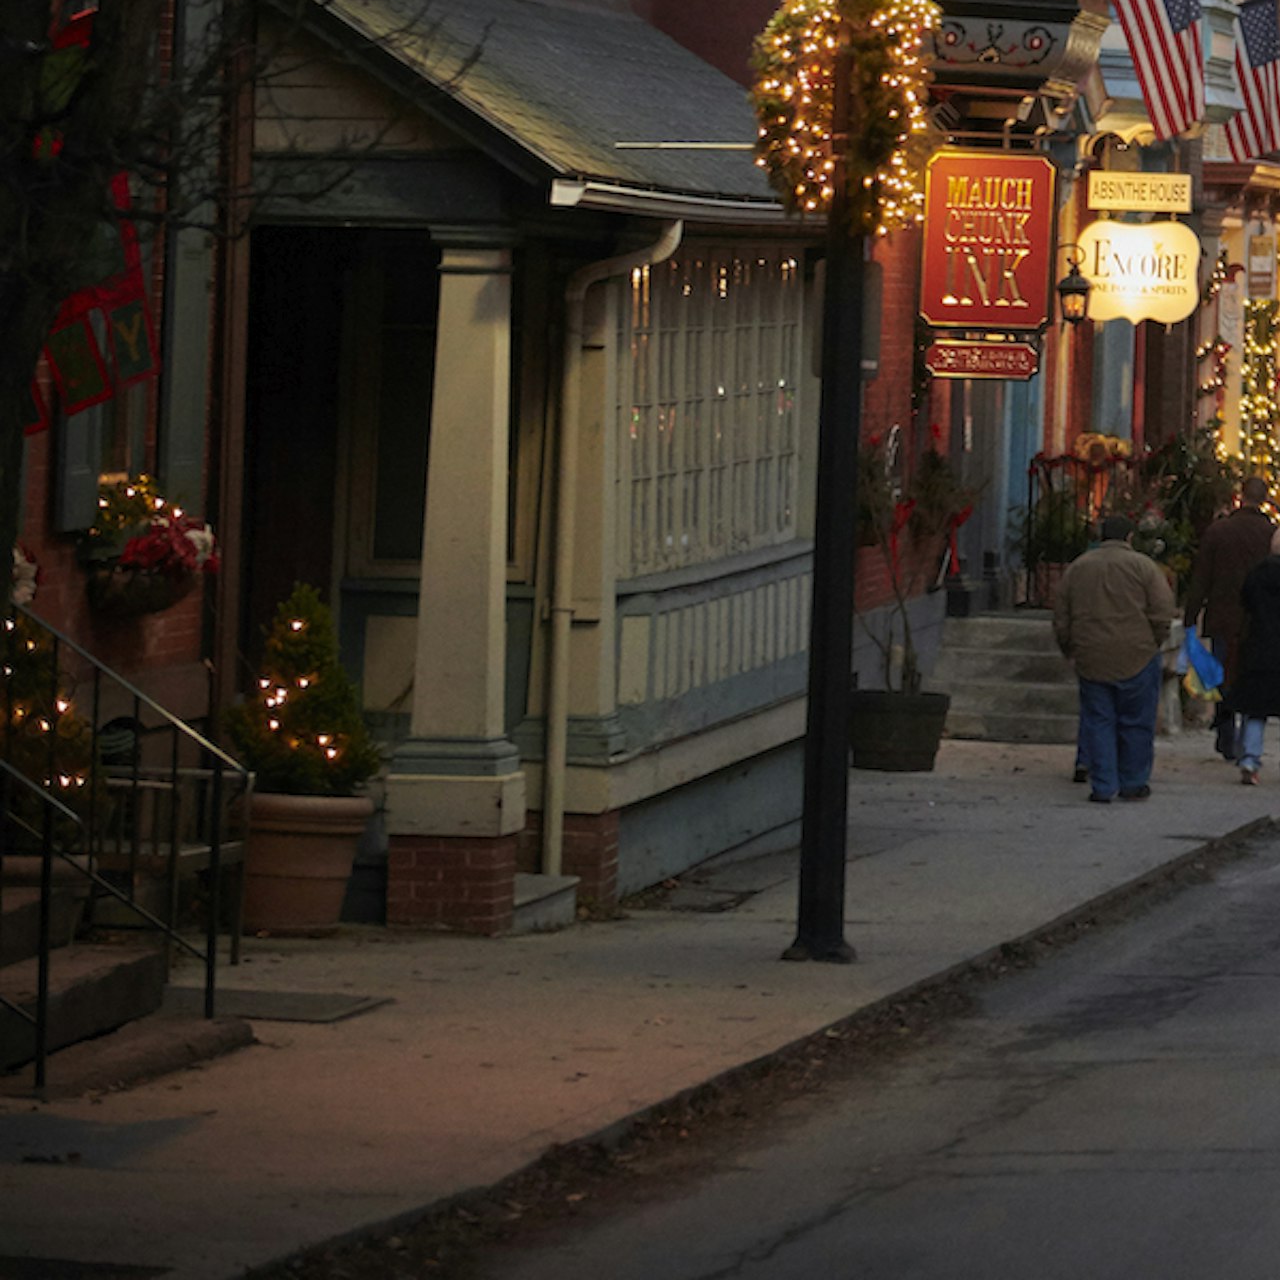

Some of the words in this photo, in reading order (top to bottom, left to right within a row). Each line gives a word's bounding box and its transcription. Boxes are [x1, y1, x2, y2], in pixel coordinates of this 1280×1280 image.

[945, 175, 1034, 210] MAUCH
[1092, 180, 1147, 202] ABSINTHE
[1149, 183, 1188, 205] HOUSE
[944, 208, 1032, 244] CHUNK
[941, 245, 1031, 308] INK
